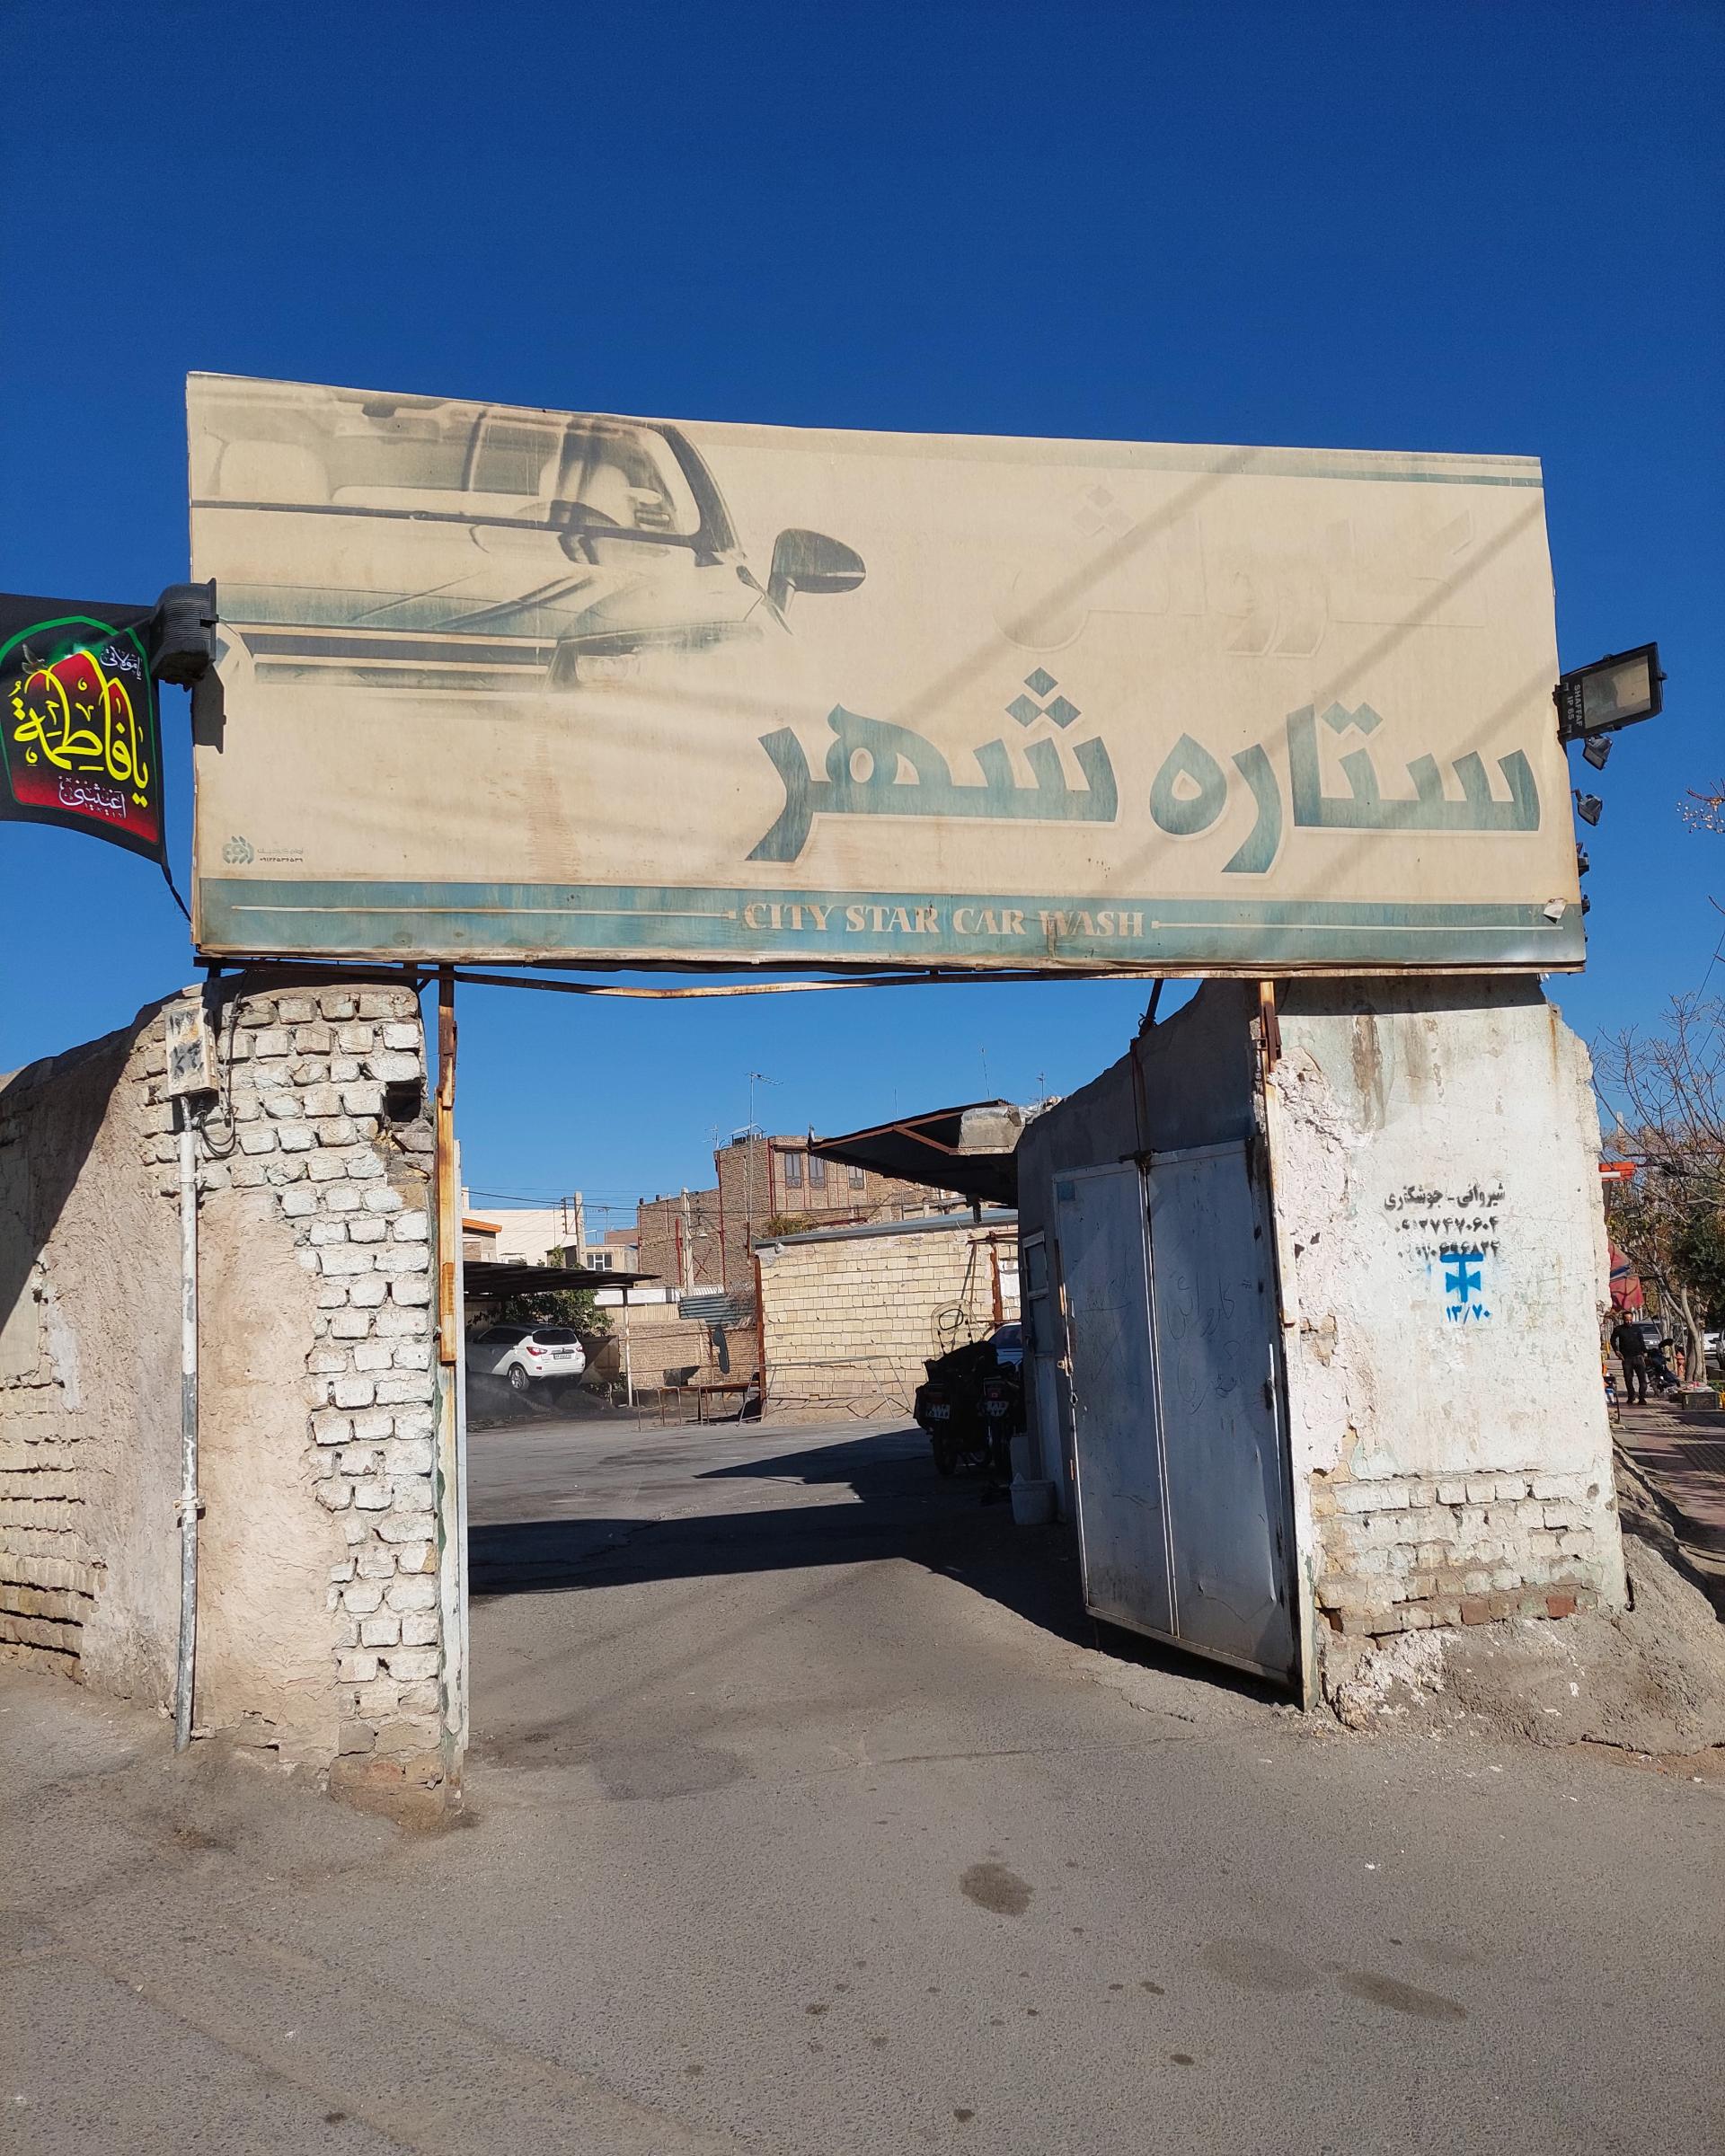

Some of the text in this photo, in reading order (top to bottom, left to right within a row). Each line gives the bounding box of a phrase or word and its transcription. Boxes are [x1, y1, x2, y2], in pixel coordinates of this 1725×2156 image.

[1567, 696, 1575, 720] IP 65
[1574, 684, 1583, 726] SHAFFAF
[745, 667, 1541, 874] ستاره شهر
[744, 902, 1146, 938] CITY STAR CAR WASH
